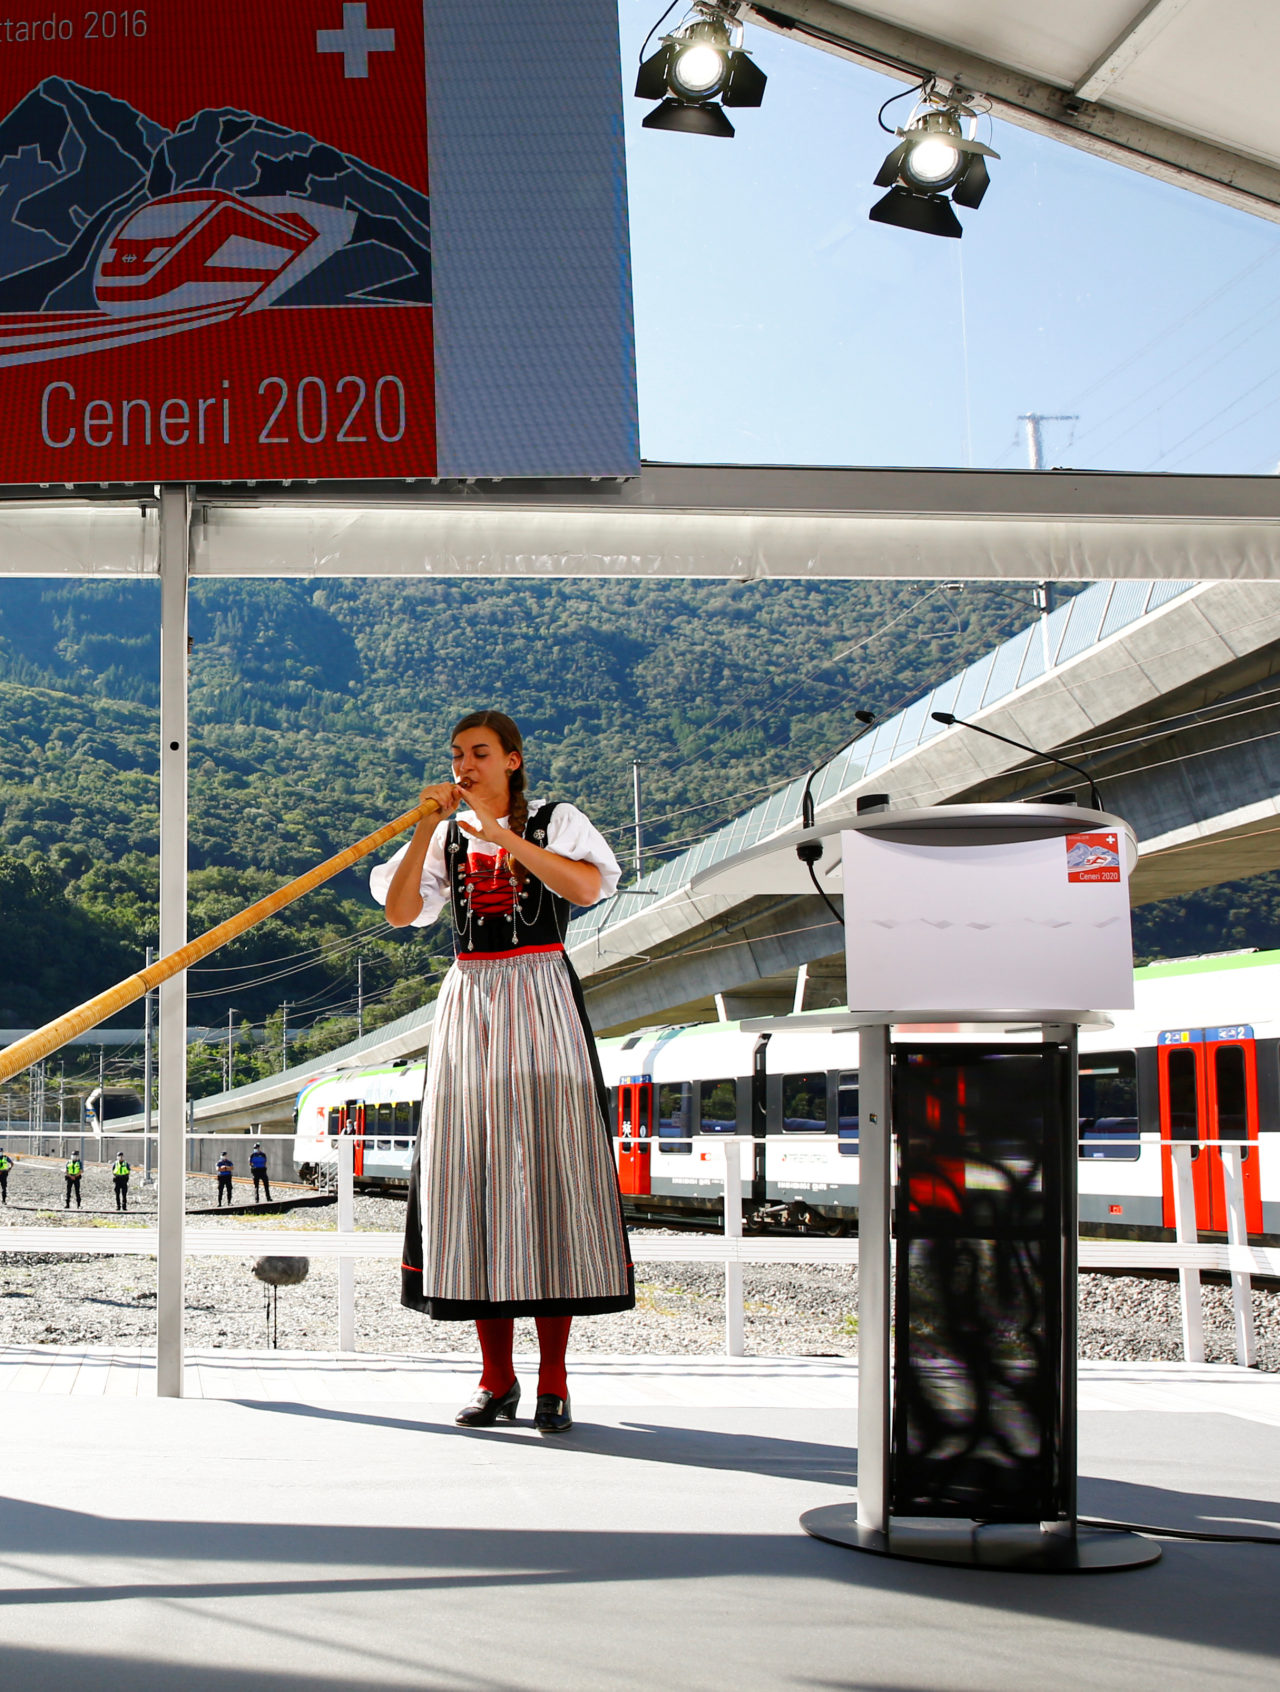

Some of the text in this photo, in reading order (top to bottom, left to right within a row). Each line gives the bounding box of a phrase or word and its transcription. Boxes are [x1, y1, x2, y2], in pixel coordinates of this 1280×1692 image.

[84, 9, 148, 39] 2016
[40, 374, 406, 449] Ceneri 2020
[1080, 872, 1118, 880] Ceneri 2020
[1164, 1033, 1172, 1044] 2
